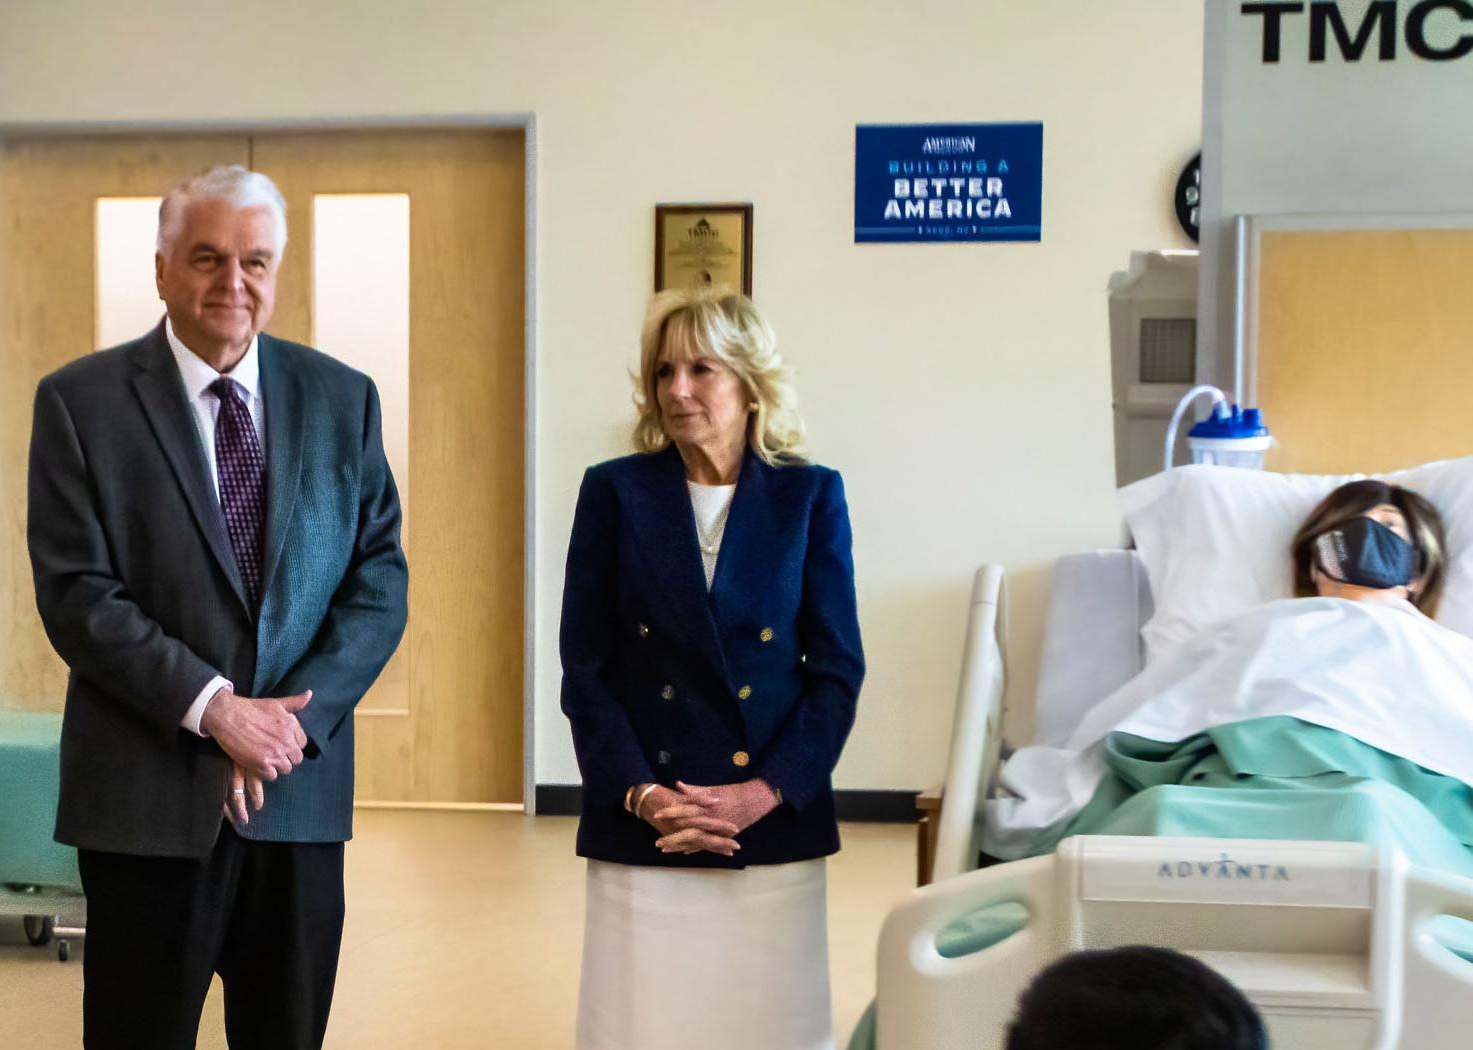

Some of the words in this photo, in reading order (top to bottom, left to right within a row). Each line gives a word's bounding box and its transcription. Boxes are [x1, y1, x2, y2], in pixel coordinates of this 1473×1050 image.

[1241, 1, 1473, 63] TMC
[889, 159, 988, 175] BUILDING
[998, 158, 1009, 174] A
[894, 177, 1004, 198] BETTER
[884, 198, 1012, 220] AMERICA
[1158, 859, 1289, 881] ADVANTA
